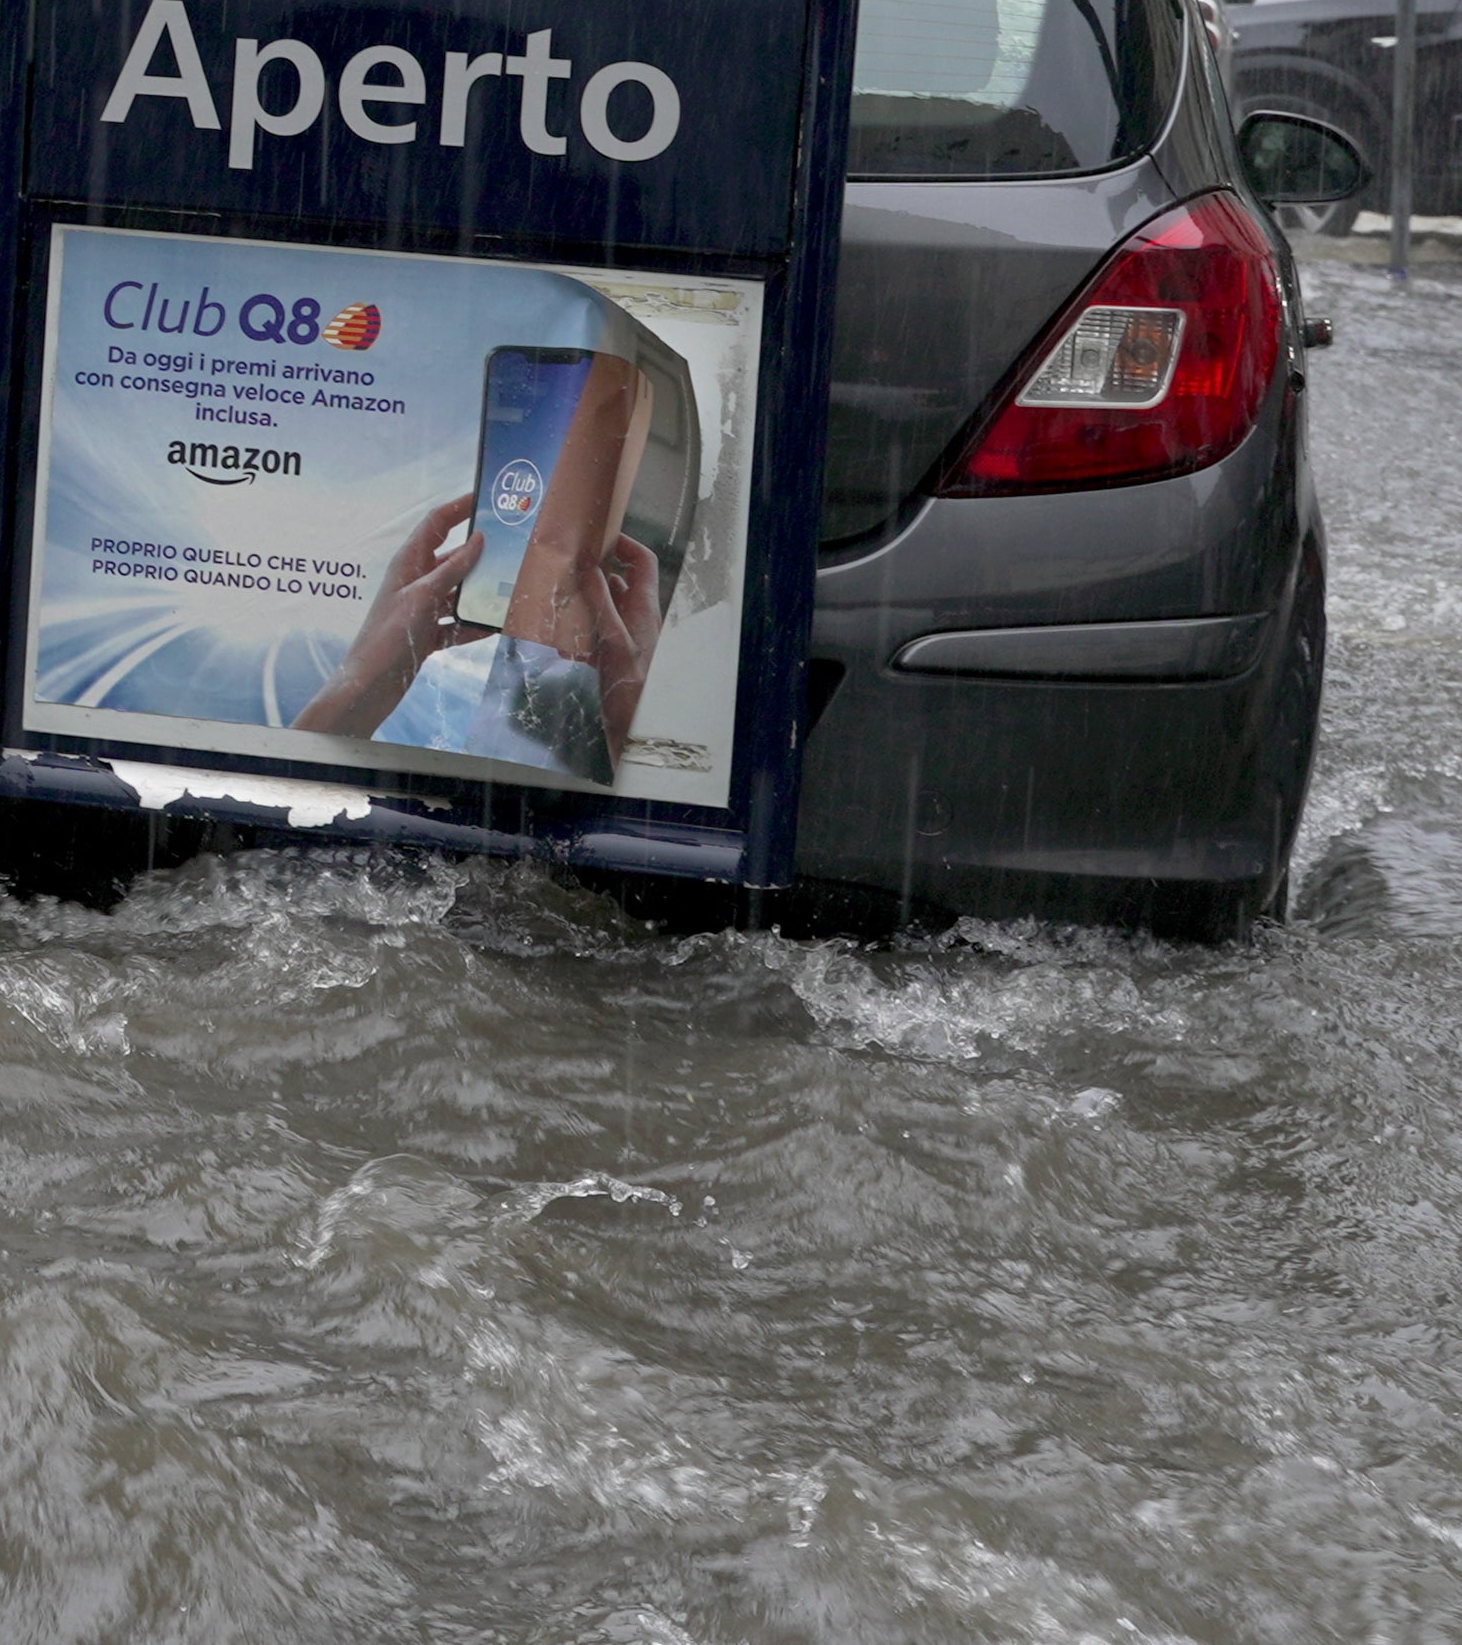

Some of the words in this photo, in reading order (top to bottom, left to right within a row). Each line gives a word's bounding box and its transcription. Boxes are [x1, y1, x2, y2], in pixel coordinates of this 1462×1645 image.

[103, 280, 227, 337] Club
[239, 292, 321, 345] Q8
[108, 346, 137, 365] Da
[143, 350, 193, 372] oggi
[199, 354, 205, 371] i
[211, 356, 277, 378] premi
[282, 362, 375, 386] arrivano
[75, 370, 114, 388] con
[120, 374, 226, 399] consegna
[232, 382, 305, 405] veloce
[311, 388, 406, 415] Amazon
[195, 402, 278, 427] inclusa.
[167, 439, 302, 476] amazon
[497, 493, 518, 511] Q8
[500, 471, 536, 493] Club
[90, 537, 177, 560] PROPRIO
[182, 546, 262, 569] QUELLO
[267, 555, 307, 573] CHE
[311, 559, 367, 580] VUOI.
[92, 559, 179, 582] PROPRIO
[183, 568, 271, 592] QUANDO
[276, 578, 303, 594] LO
[307, 581, 363, 601] VUOI.
